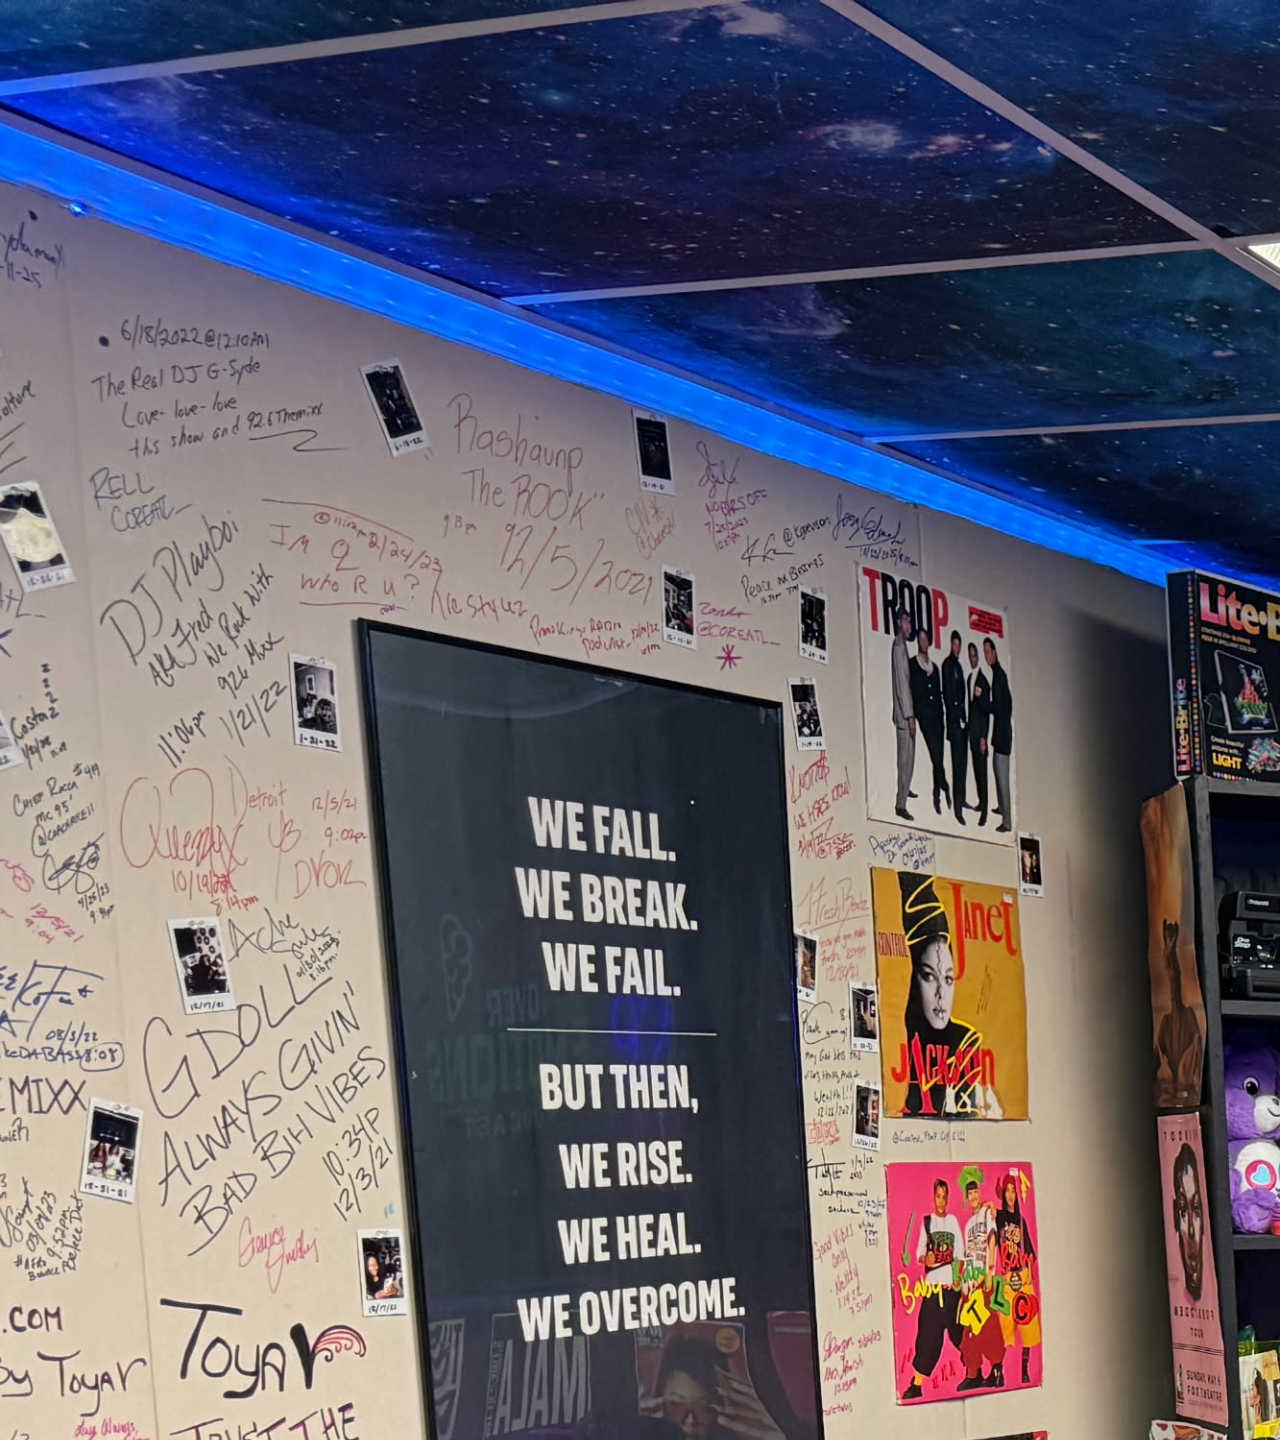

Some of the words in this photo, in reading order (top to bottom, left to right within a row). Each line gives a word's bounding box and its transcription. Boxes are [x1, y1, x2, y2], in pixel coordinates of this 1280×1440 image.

[92, 373, 126, 403] The
[862, 566, 949, 650] TROOP
[1212, 752, 1243, 770] LIGHT
[528, 796, 588, 852] WE
[594, 804, 677, 862] FALL.
[514, 866, 575, 923] WE
[581, 874, 699, 931] BREAK.
[541, 941, 600, 993] WE
[604, 945, 682, 998] FAIL.
[539, 1062, 607, 1112] BUT
[609, 1063, 700, 1115] THEN,
[178, 1170, 258, 1258] BAD
[303, 1045, 387, 1124] VIBES
[558, 1141, 611, 1190] WE
[617, 1140, 694, 1187] RISE.
[557, 1217, 611, 1265] WE
[616, 1211, 702, 1260] HEAL.
[517, 1295, 574, 1343] WE
[579, 1276, 746, 1337] OVERCOME.
